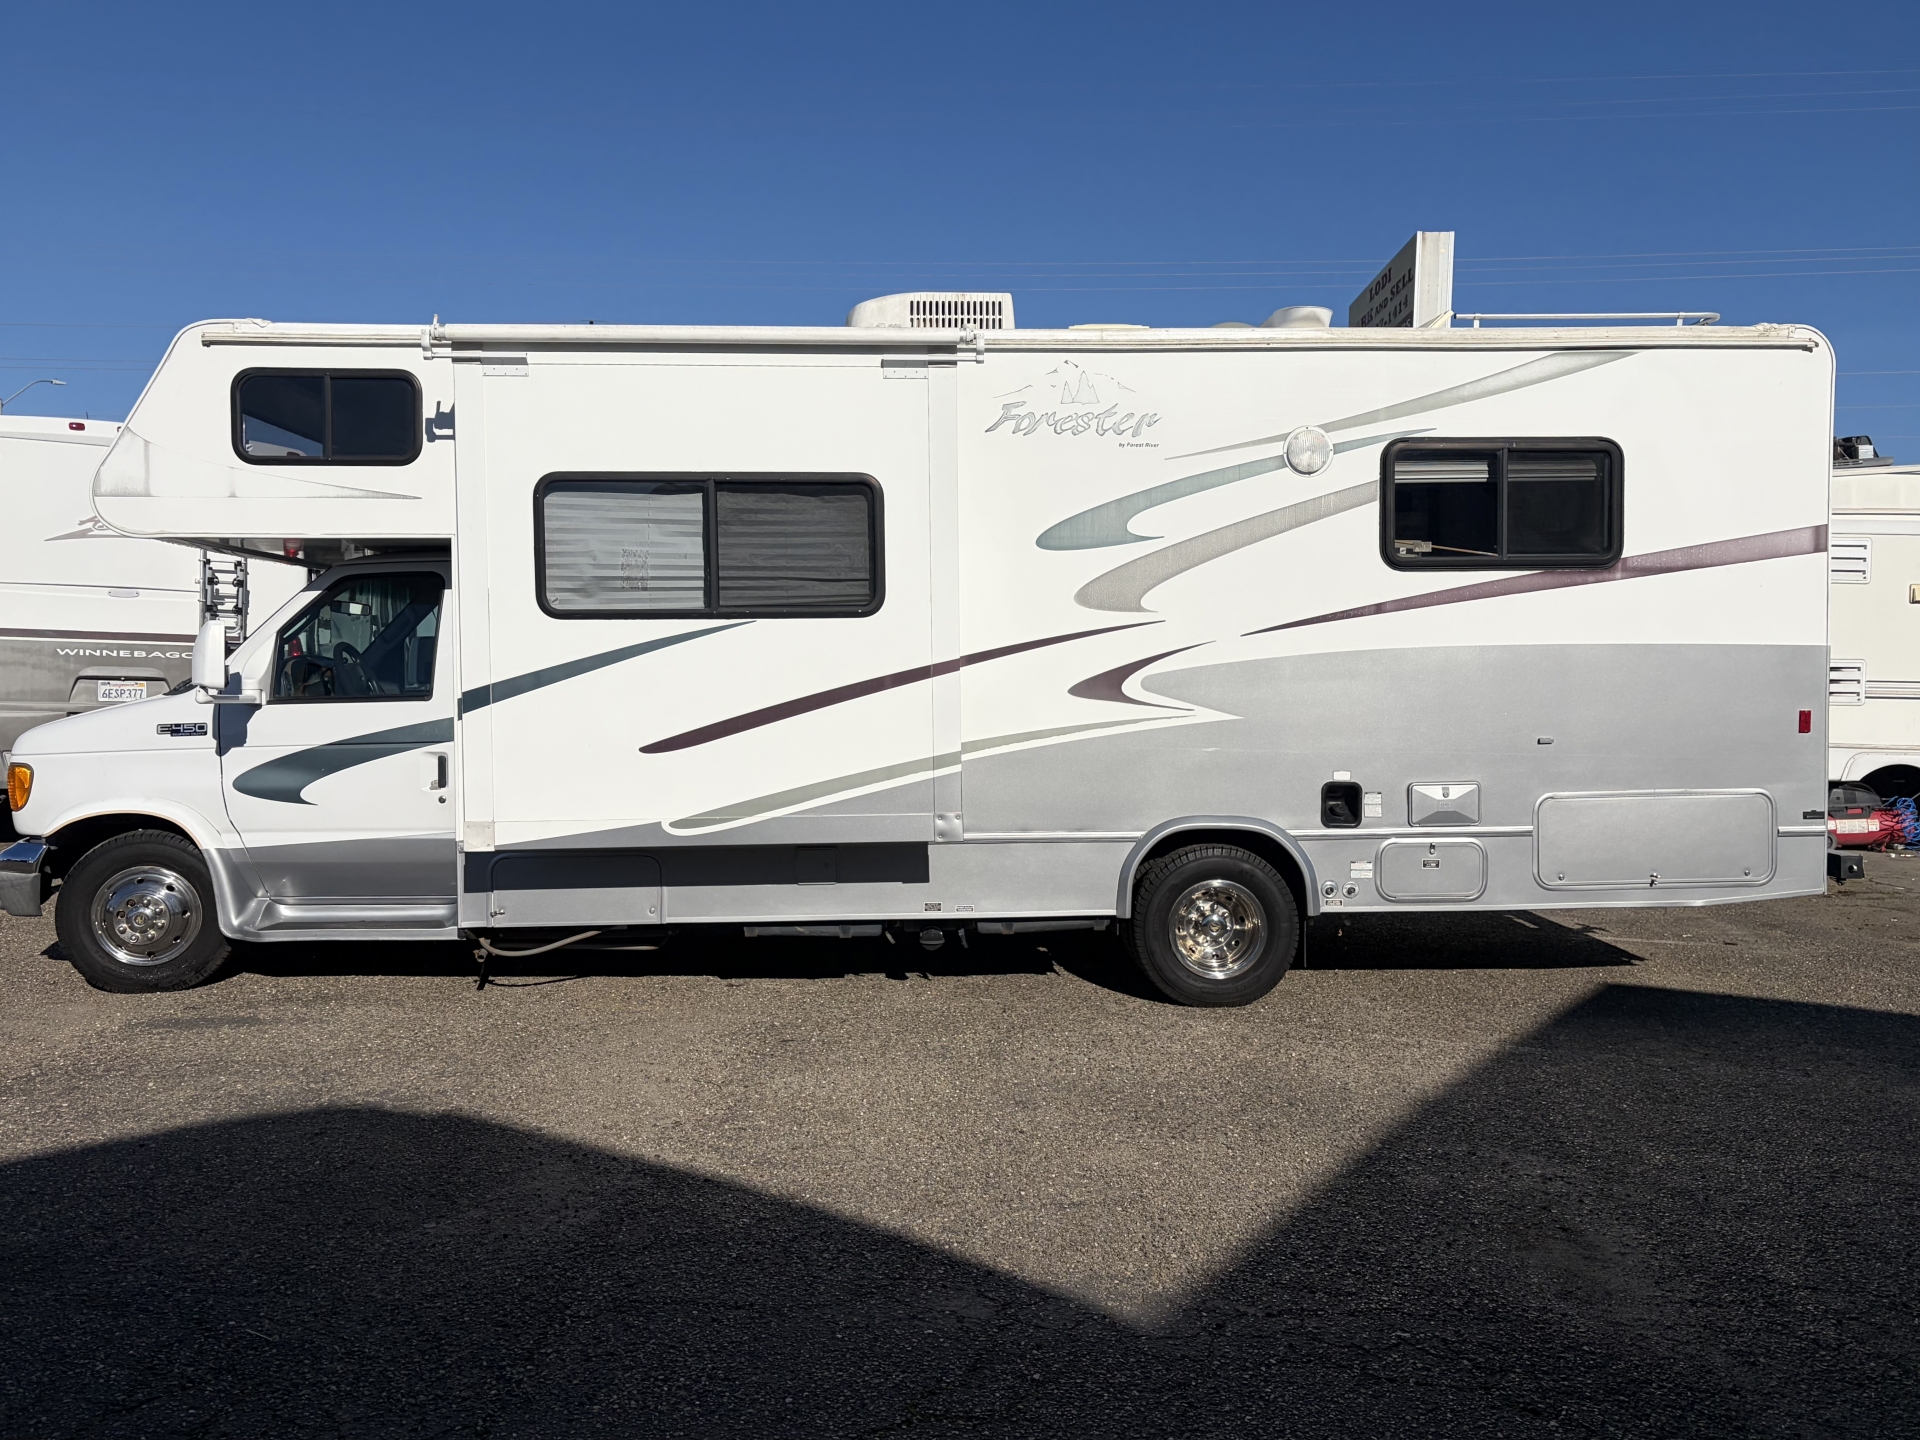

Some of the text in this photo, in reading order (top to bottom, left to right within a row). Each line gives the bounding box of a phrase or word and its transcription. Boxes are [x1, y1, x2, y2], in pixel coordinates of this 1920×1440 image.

[1368, 267, 1392, 303] LODI
[1374, 296, 1389, 318] AND
[1389, 267, 1414, 302] SELL
[984, 400, 1163, 438] Forester
[101, 688, 144, 699] 6ESP377
